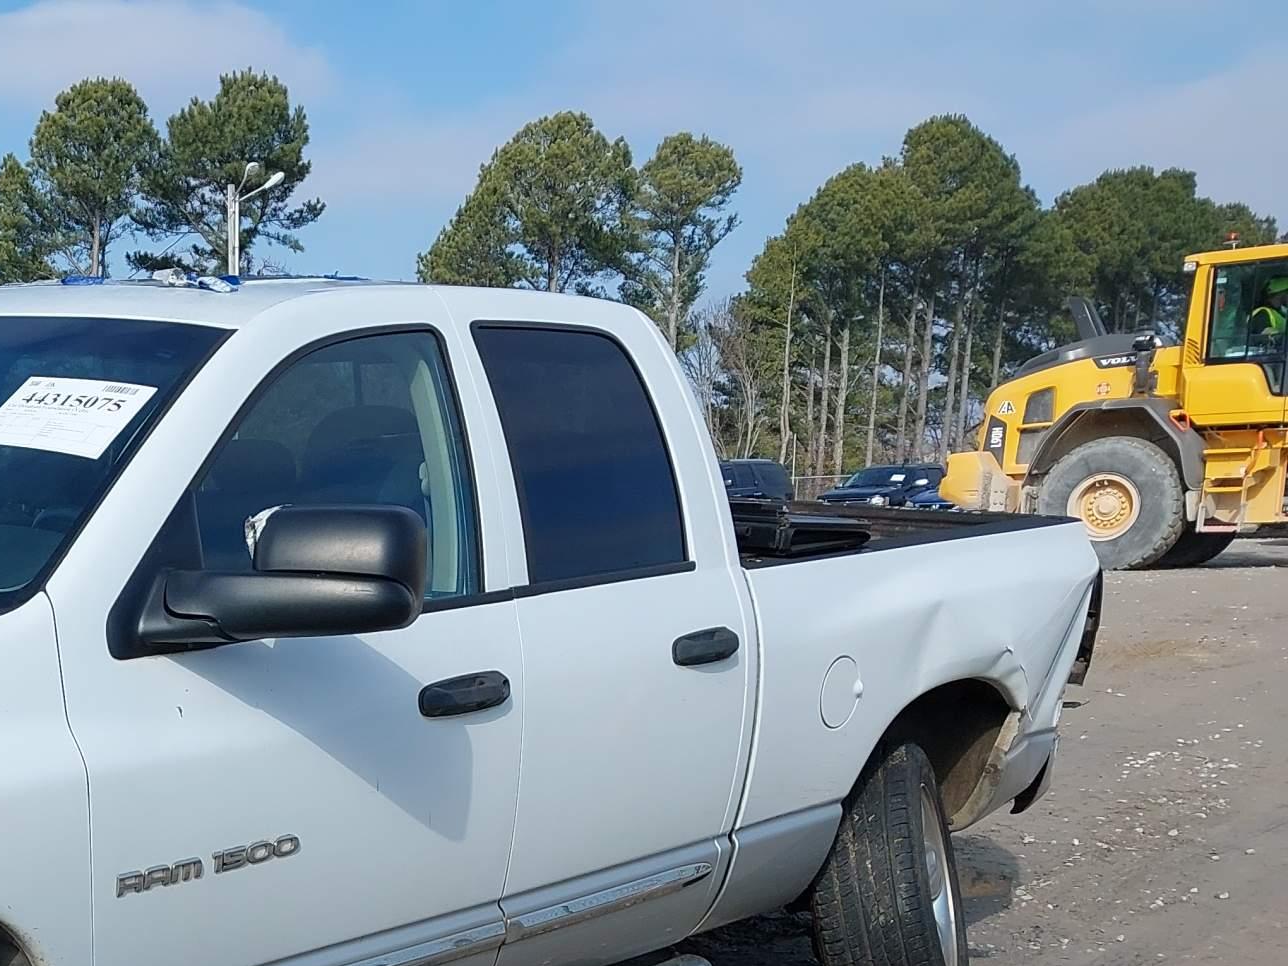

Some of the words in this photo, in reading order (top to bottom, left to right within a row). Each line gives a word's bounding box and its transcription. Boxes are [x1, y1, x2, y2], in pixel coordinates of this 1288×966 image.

[1100, 356, 1138, 366] VOLV
[22, 391, 127, 412] 44315075
[990, 427, 1004, 448] L90H
[115, 857, 204, 898] RAM
[211, 834, 301, 874] 1500
